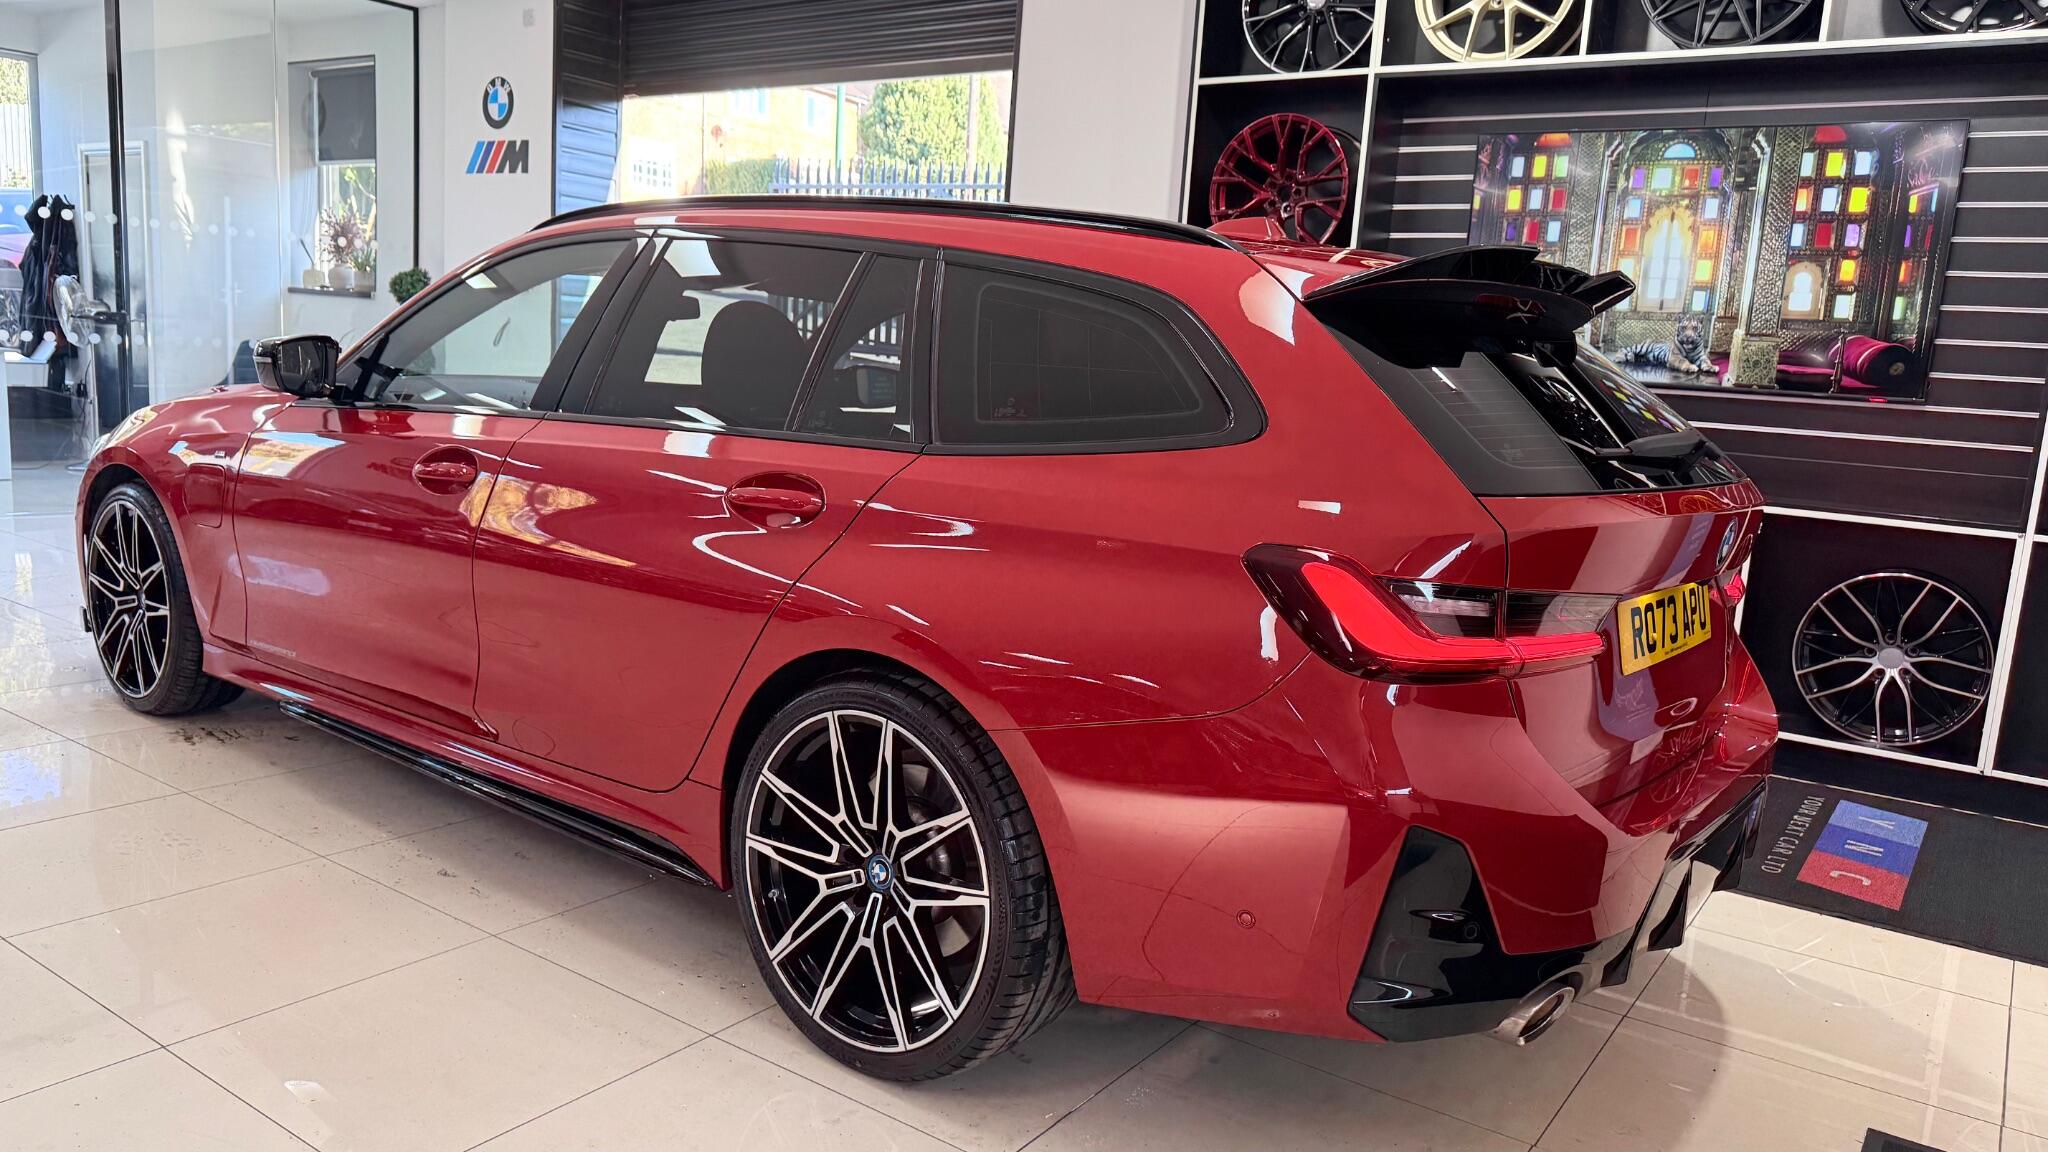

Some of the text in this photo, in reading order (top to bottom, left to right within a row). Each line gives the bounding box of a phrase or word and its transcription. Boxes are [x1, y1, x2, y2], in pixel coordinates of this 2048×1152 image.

[1631, 586, 1706, 659] RO73 APU
[1761, 796, 1825, 873] YOUR NEXT CAR LTD
